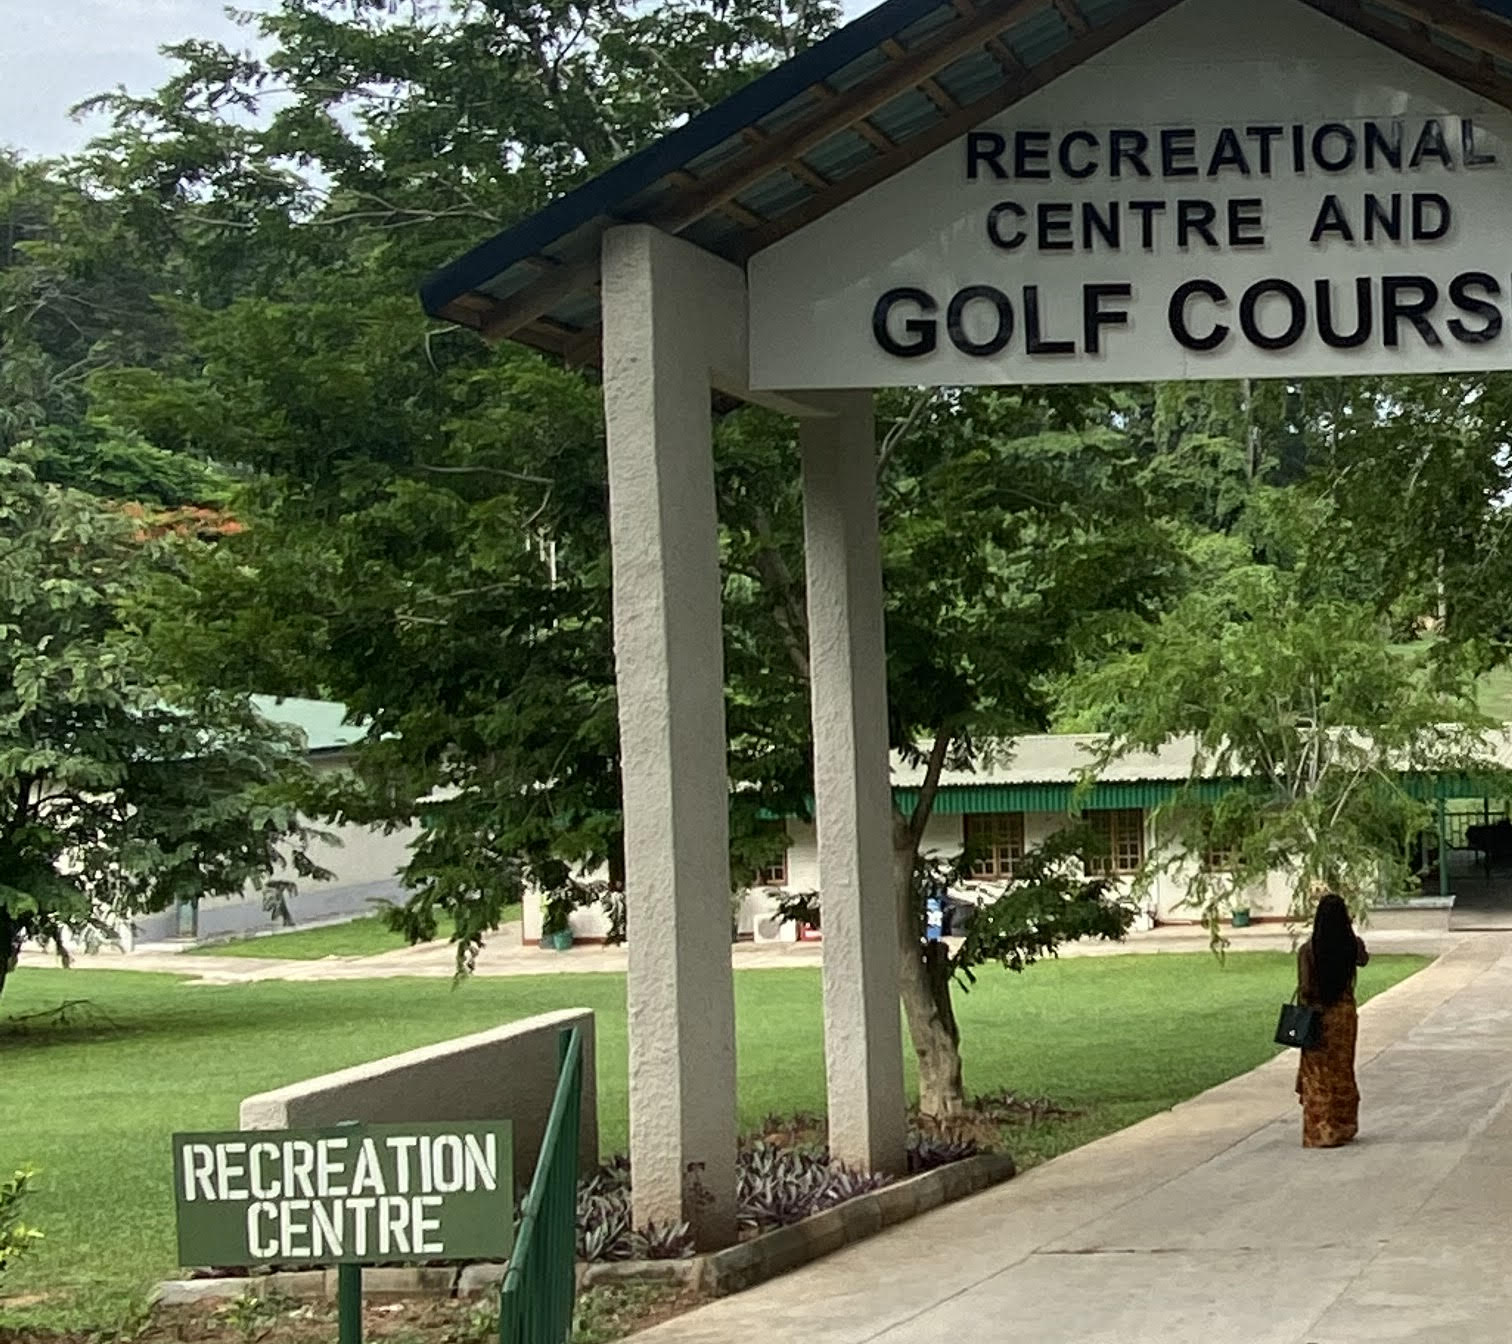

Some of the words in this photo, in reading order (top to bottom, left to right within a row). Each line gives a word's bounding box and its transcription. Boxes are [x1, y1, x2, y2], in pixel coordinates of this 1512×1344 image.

[966, 118, 1496, 181] RECREATIONAL
[986, 196, 1266, 252] CENTRE
[1308, 192, 1453, 244] AND
[870, 282, 1132, 359] GOLF
[182, 1132, 498, 1202] RECREATION
[247, 1195, 444, 1259] CENTRE
